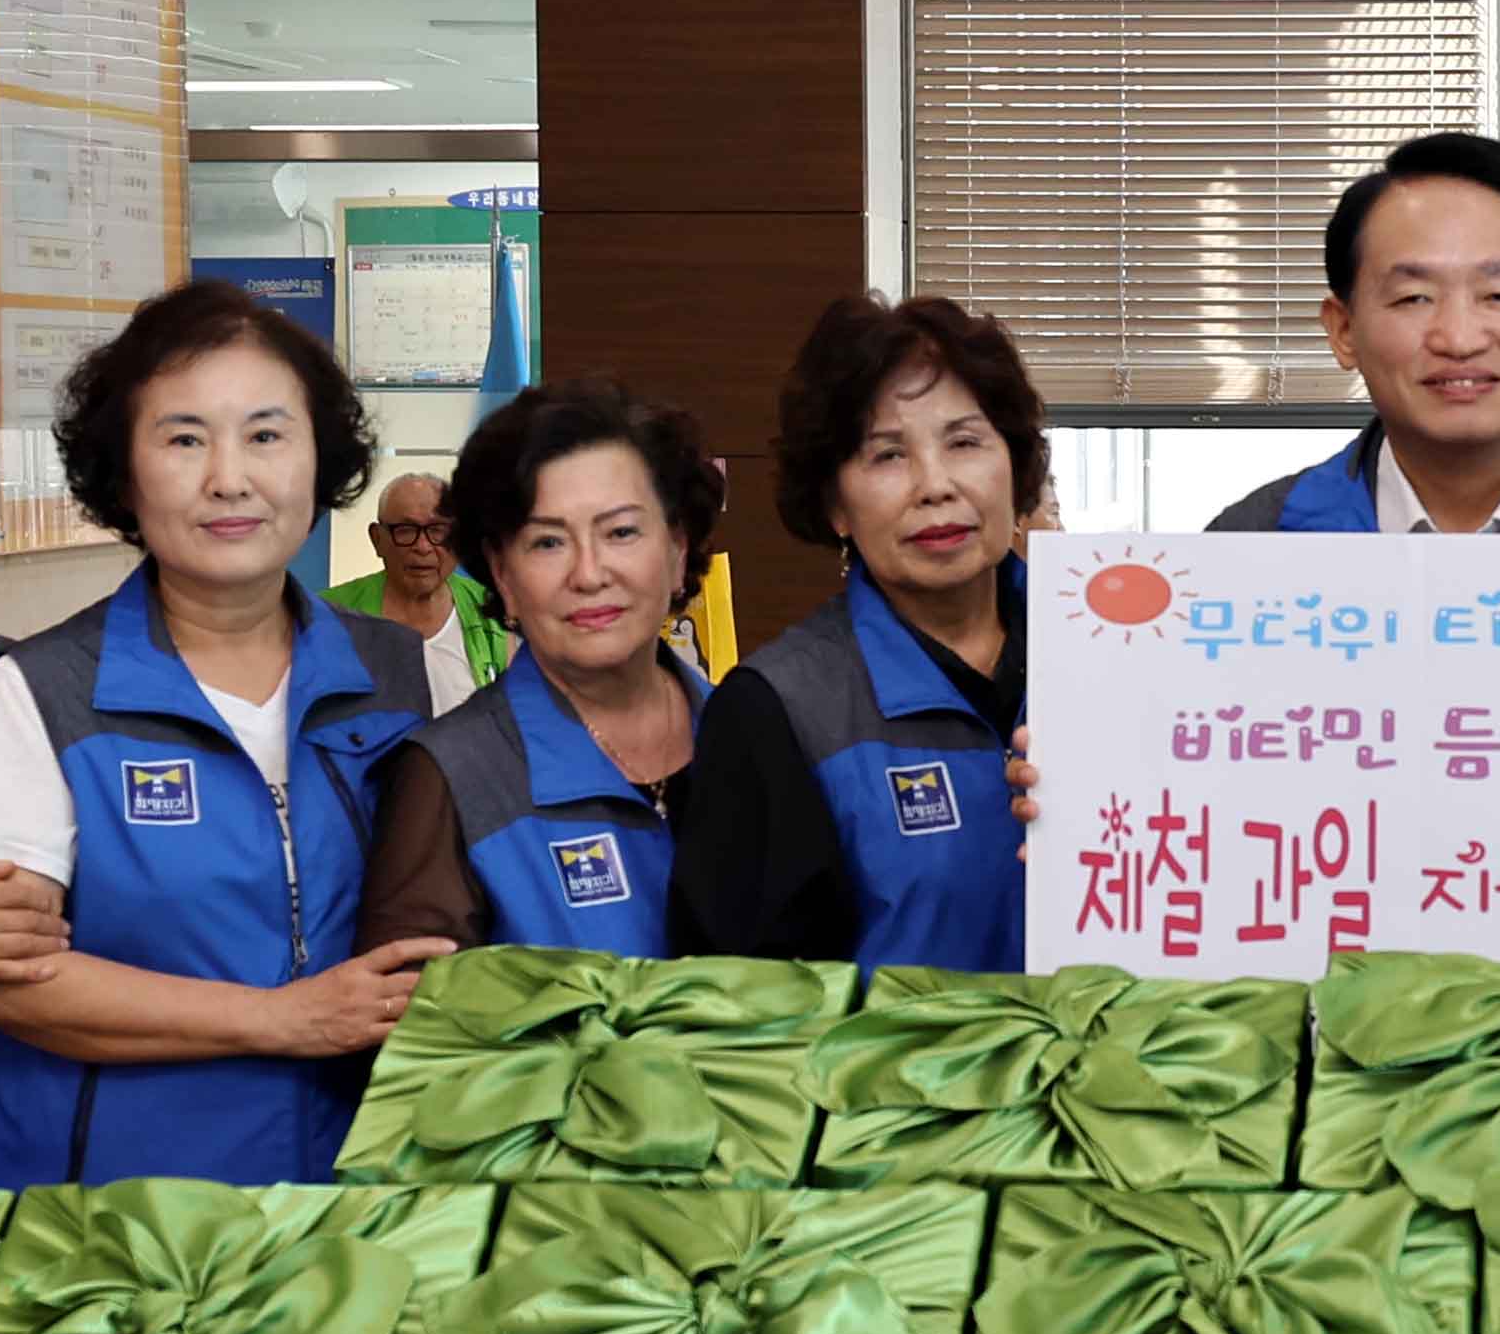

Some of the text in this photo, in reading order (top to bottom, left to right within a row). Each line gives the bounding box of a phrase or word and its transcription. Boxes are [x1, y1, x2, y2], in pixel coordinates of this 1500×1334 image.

[1188, 592, 1397, 661] 무더위
[1172, 706, 1396, 769] 비타민
[1076, 789, 1211, 959] 제철
[1237, 799, 1378, 954] 과일
